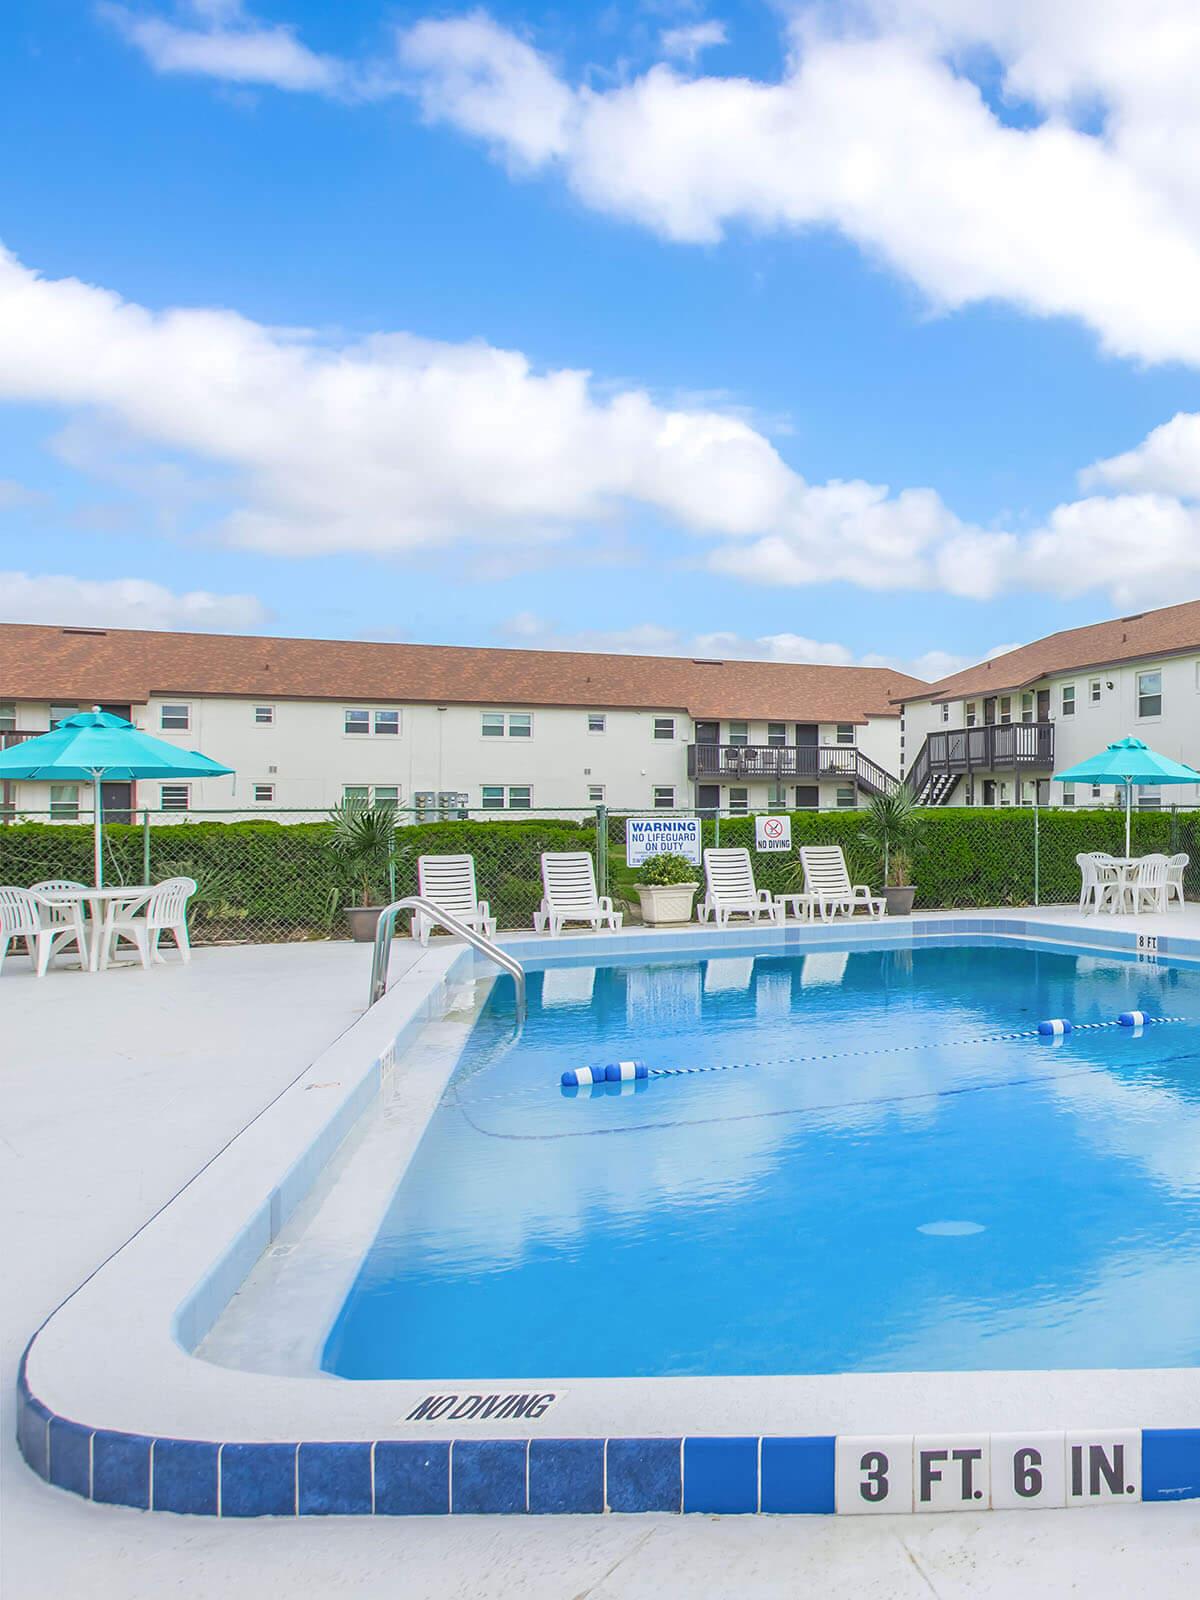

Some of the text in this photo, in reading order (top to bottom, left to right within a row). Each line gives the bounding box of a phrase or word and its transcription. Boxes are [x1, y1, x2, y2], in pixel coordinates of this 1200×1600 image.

[632, 822, 696, 832] WARNING
[632, 833, 696, 842] NO LIFEGUARD
[645, 842, 684, 851] ON DUTY
[758, 840, 790, 848] NO DIVING
[1139, 935, 1145, 947] 8
[405, 1393, 556, 1421] NO DIVING
[859, 1444, 1136, 1502] 3 FT. 6 IN.
